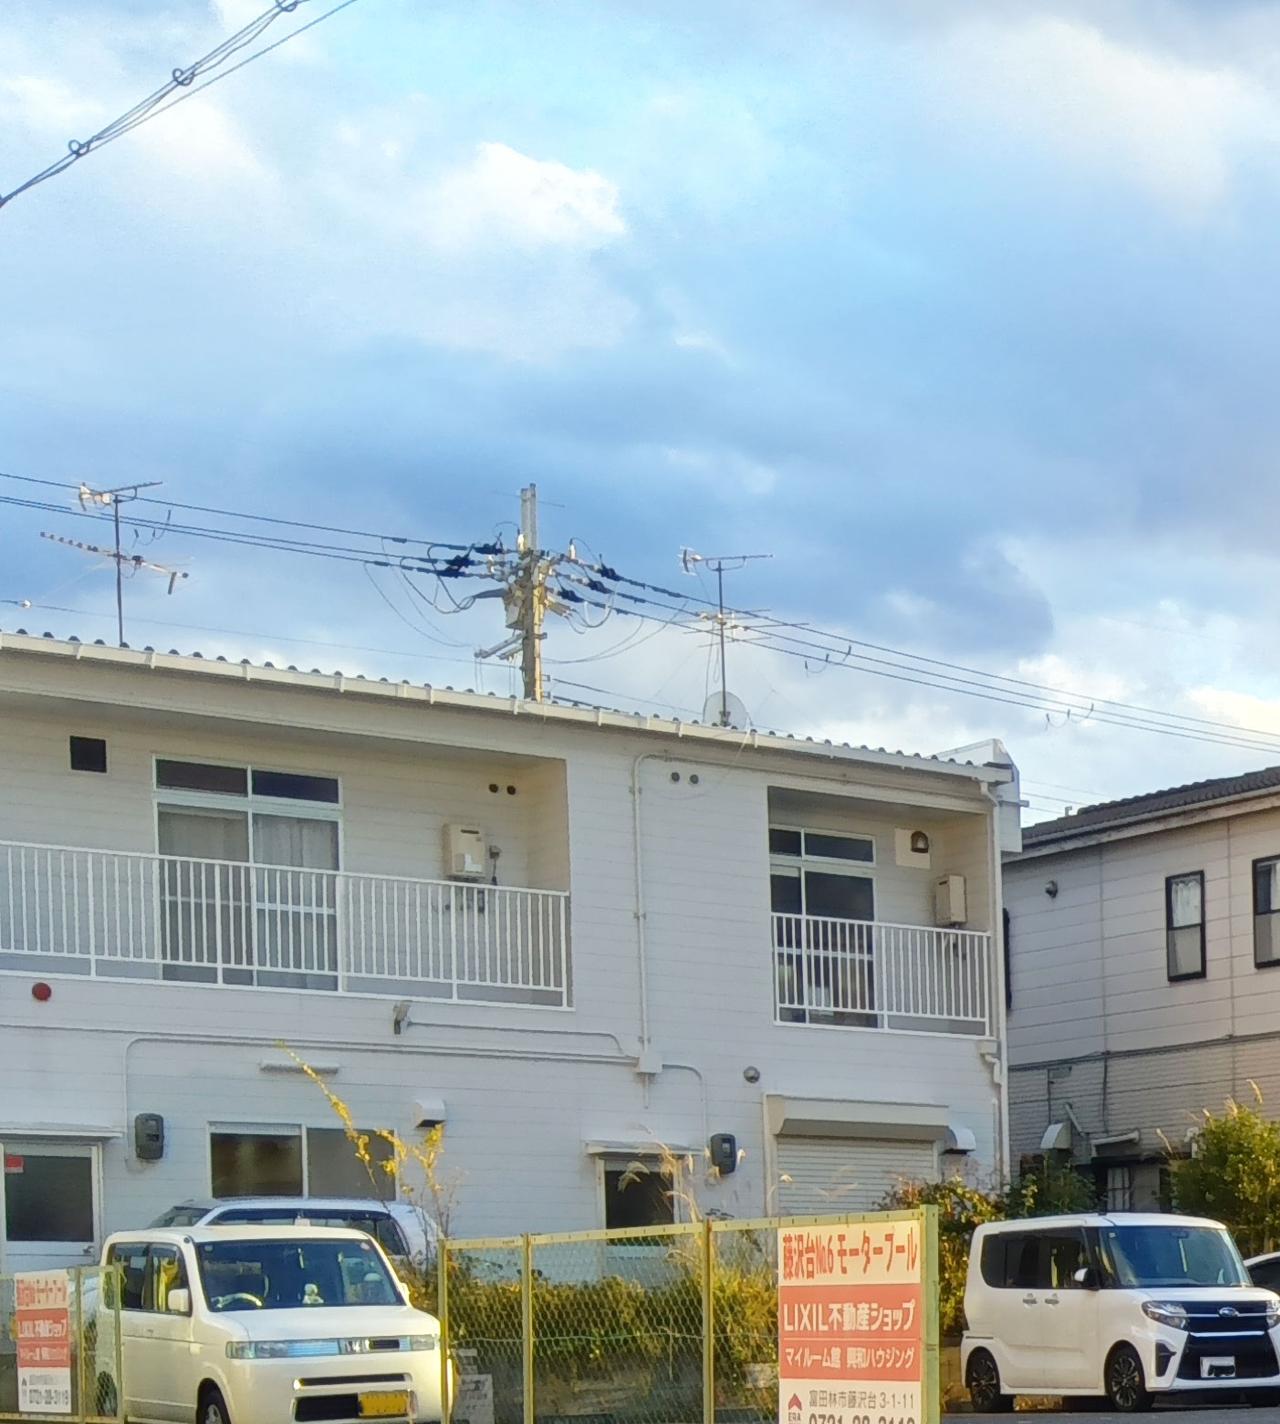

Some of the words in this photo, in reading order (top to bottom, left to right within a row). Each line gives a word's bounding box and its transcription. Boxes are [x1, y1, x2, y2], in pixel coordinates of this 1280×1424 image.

[783, 1299, 915, 1331] LIXIL不動産ショップ
